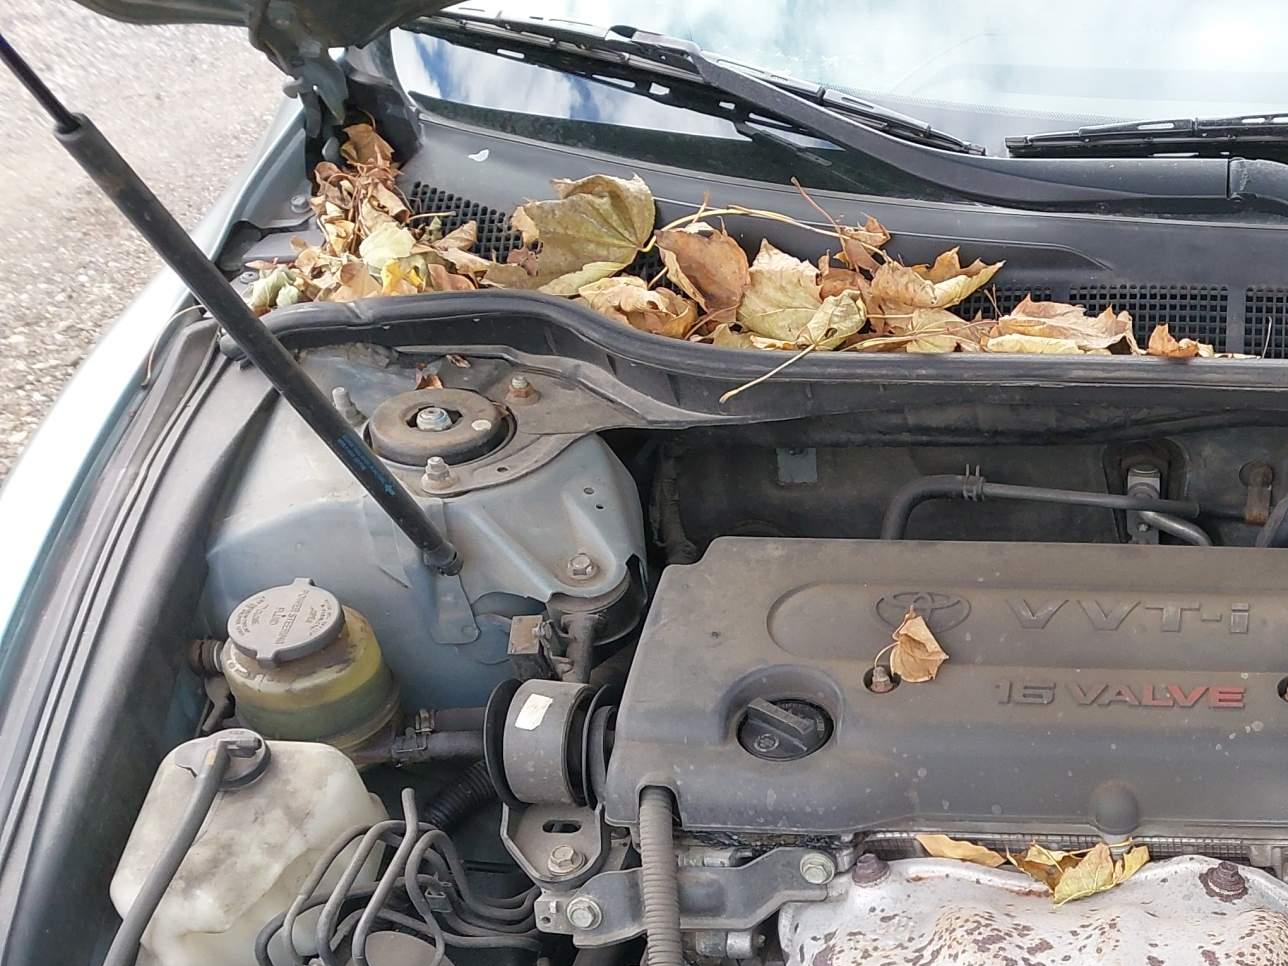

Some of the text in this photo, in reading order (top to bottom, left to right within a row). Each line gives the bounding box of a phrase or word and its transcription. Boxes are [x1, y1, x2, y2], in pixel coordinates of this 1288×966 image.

[1006, 598, 1250, 635] VVT-i
[995, 682, 1247, 709] 16 VALVE
